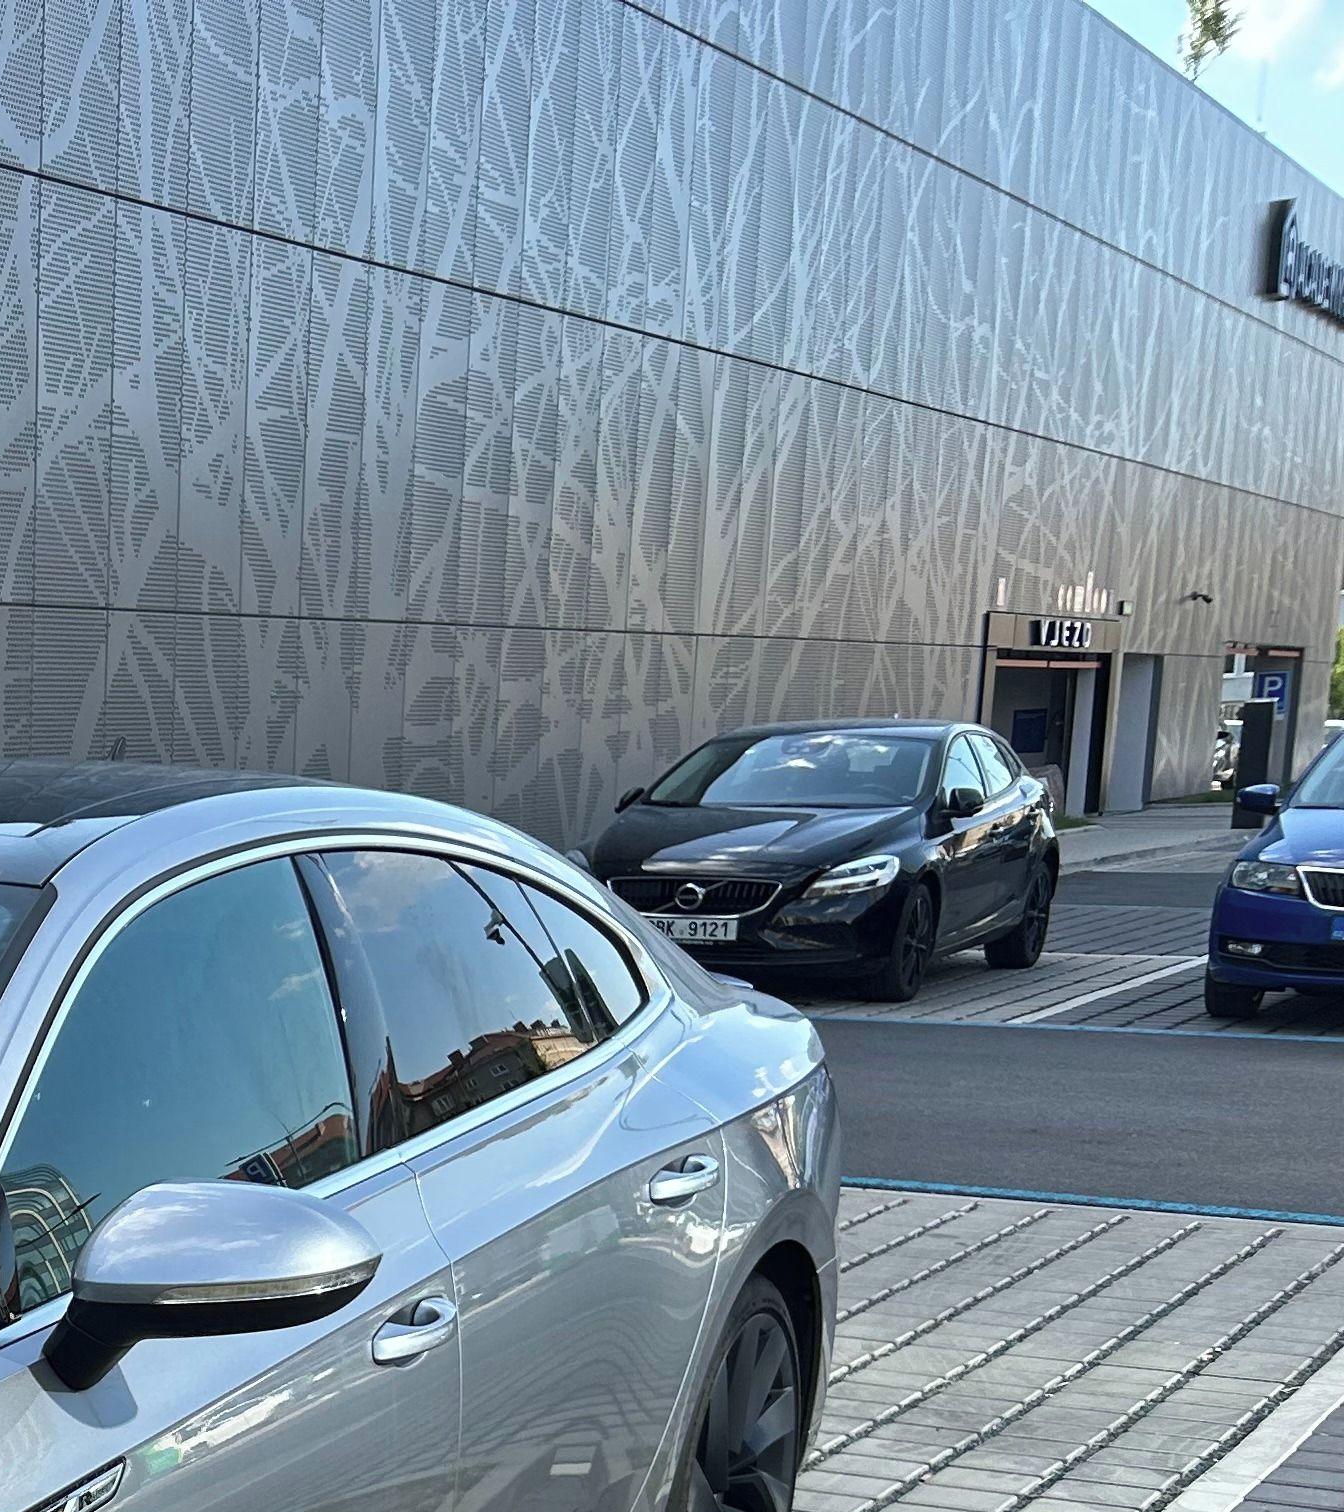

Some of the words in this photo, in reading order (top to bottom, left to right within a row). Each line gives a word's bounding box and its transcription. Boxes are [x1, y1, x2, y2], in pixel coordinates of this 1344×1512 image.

[1040, 619, 1092, 648] VJEZD
[1263, 675, 1284, 698] P
[688, 921, 728, 938] 9121
